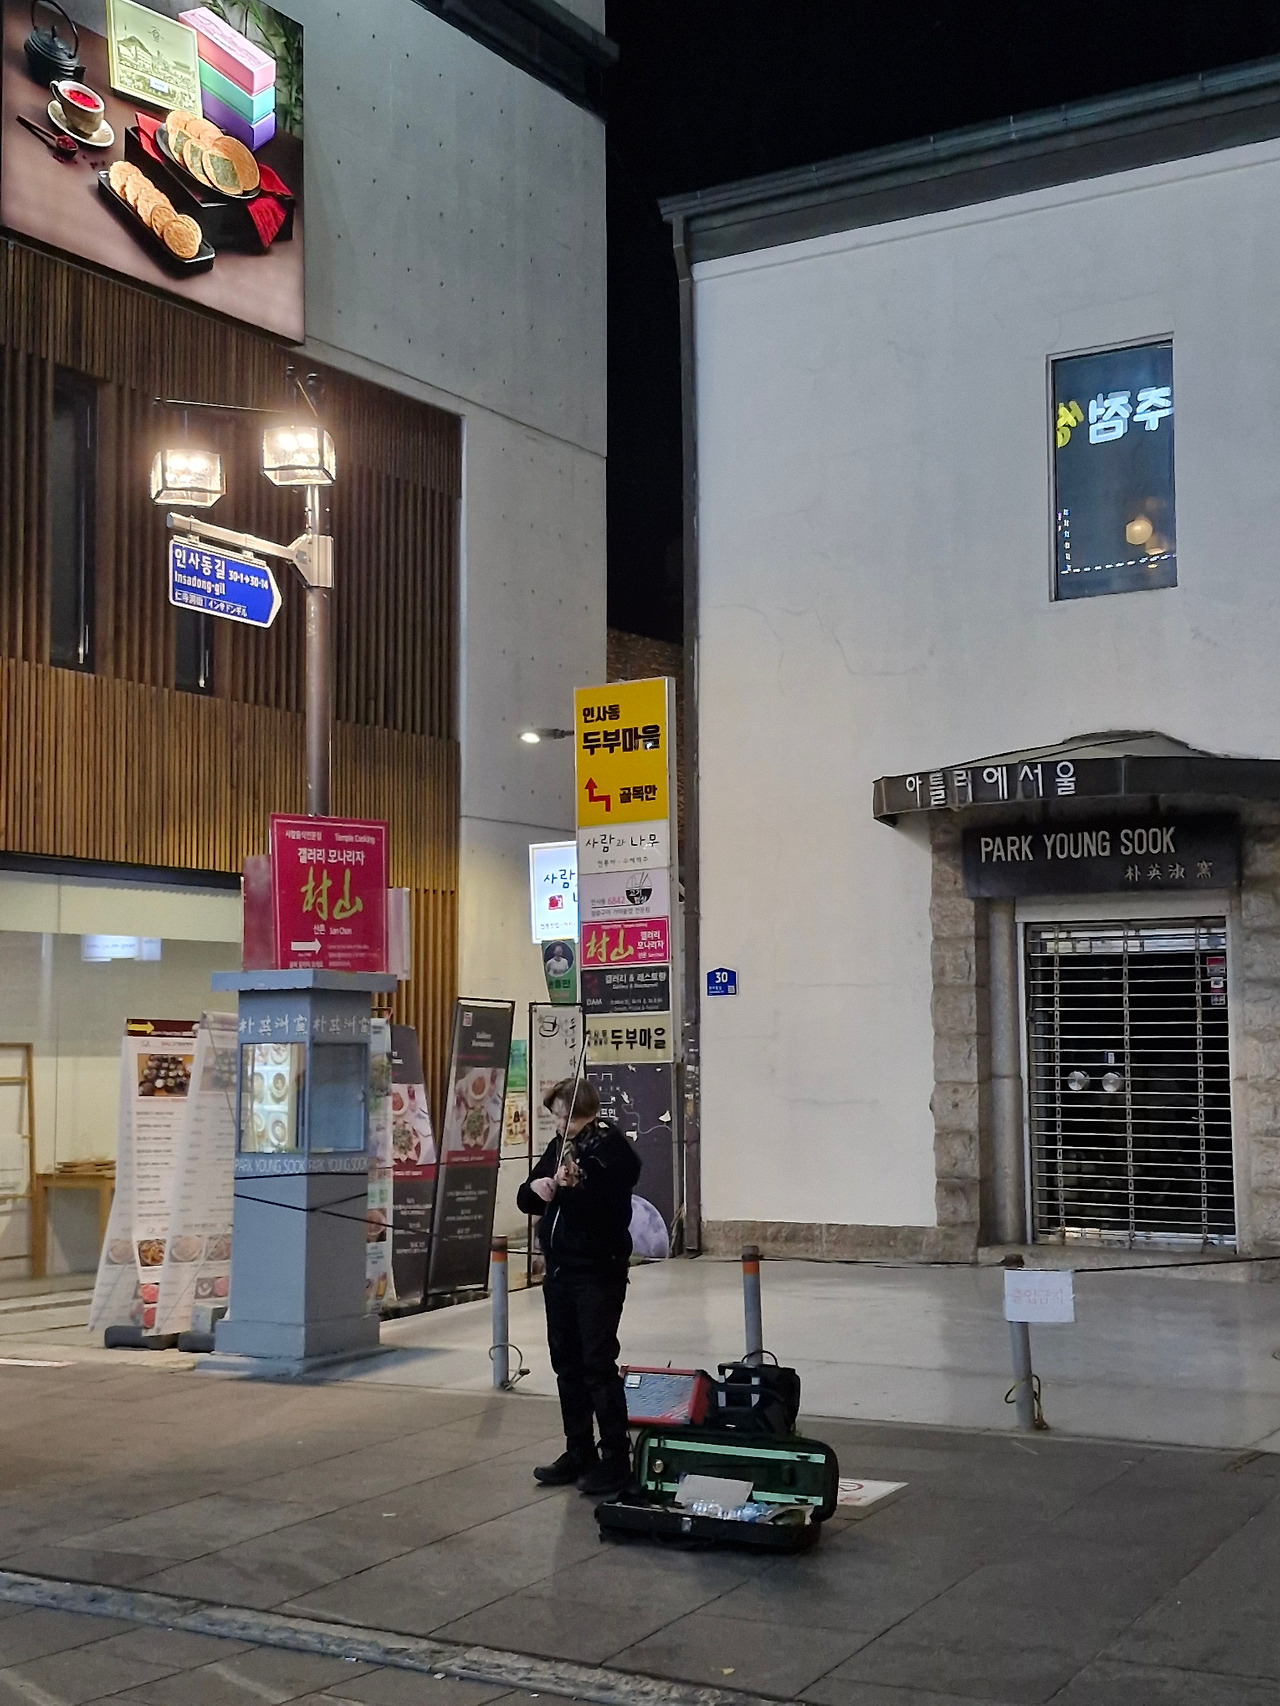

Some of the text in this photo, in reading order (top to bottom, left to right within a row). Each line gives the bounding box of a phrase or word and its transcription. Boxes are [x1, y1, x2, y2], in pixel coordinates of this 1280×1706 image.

[174, 548, 226, 580] 인사동길
[174, 571, 226, 596] Insadong-gil
[582, 704, 620, 724] 인사동
[582, 724, 661, 756] 두부마을
[619, 784, 658, 804] 골목안
[585, 833, 660, 853] 사람과 나무
[980, 826, 1176, 863] PARK YOUNG SOOK
[298, 847, 365, 866] 갤러리 모나리자
[715, 971, 728, 983] 30
[611, 1028, 667, 1050] 두부마을
